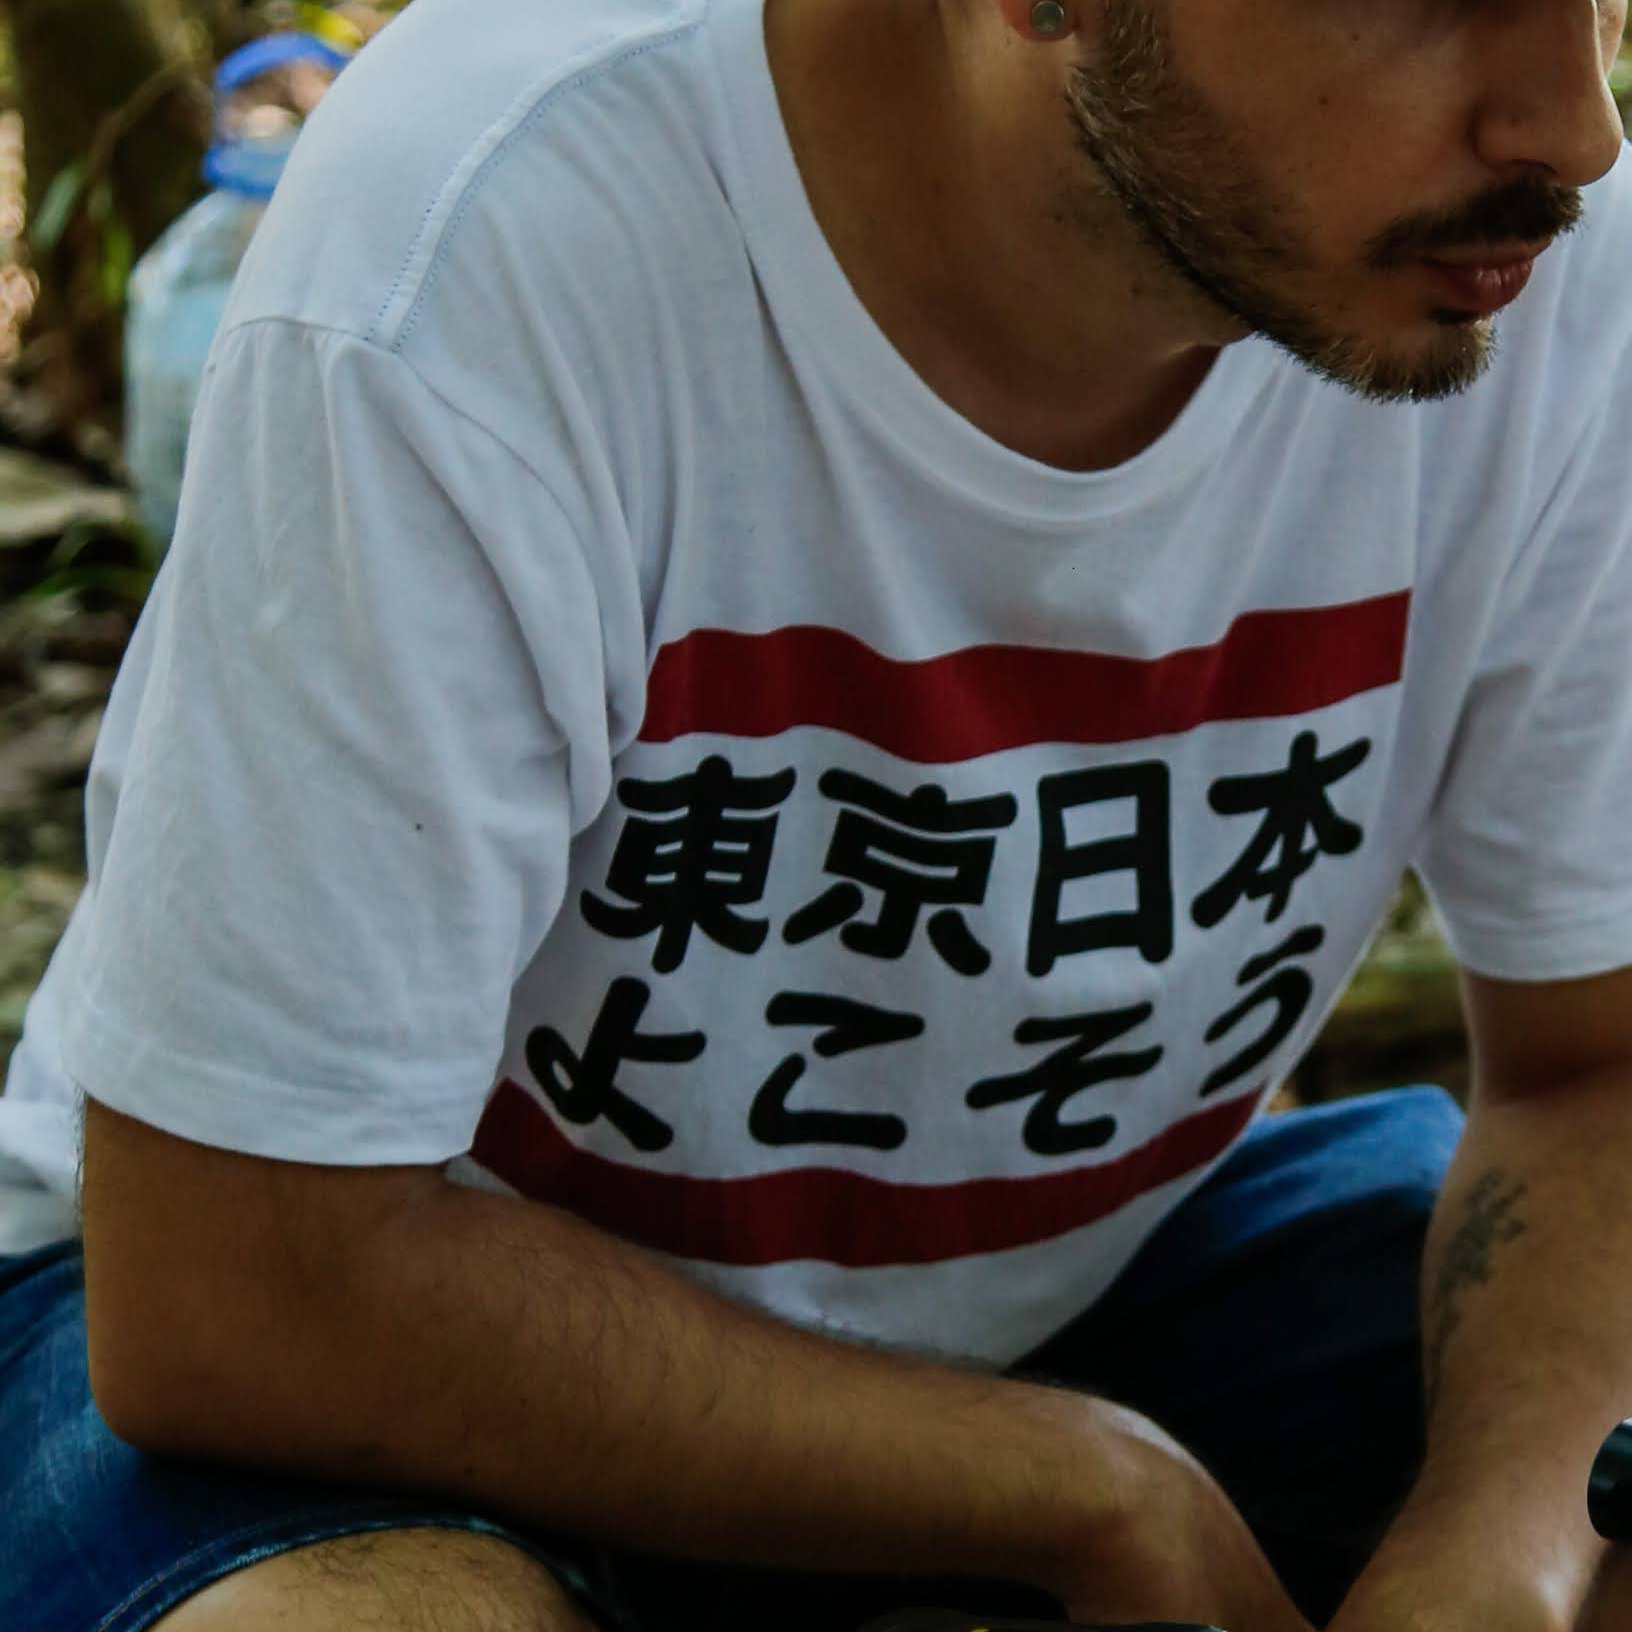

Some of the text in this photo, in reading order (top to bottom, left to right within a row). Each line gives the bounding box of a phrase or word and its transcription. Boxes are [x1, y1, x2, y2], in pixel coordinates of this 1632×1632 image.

[579, 730, 1371, 974] 東京日本
[526, 925, 1325, 1156] よこそう
